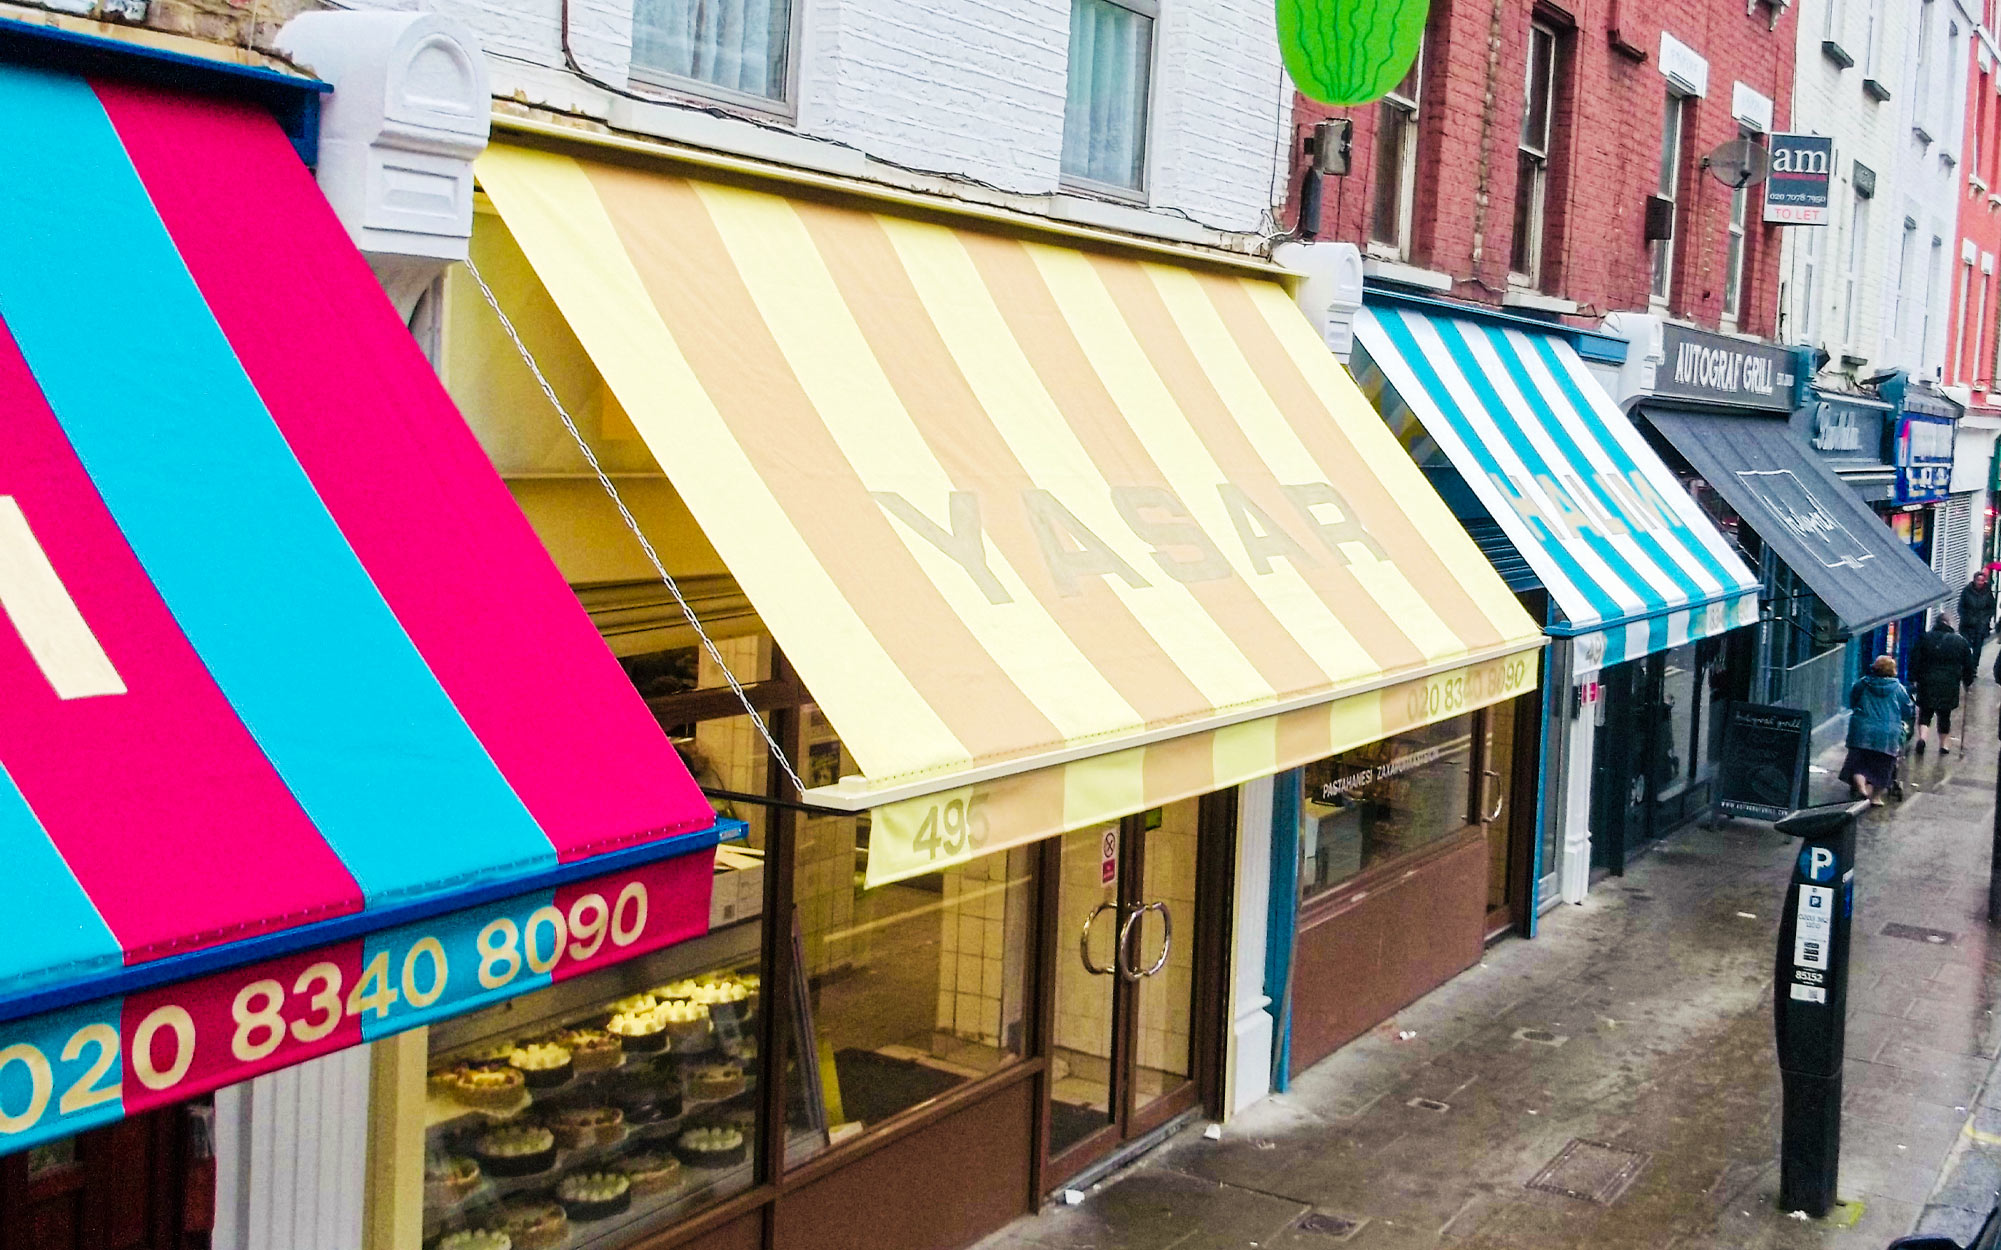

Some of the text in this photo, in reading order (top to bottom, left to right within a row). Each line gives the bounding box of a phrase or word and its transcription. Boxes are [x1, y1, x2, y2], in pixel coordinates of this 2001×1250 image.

[1773, 148, 1828, 173] am
[1769, 193, 1784, 201] 020
[1776, 208, 1820, 221] TO LET
[1674, 342, 1773, 395] AUTOGRAF GRILL
[1488, 470, 1682, 541] HALIM
[868, 481, 1389, 605] YASAR
[1408, 660, 1526, 721] 020 8340 8090
[912, 793, 990, 860] 495
[1810, 846, 1833, 880] P
[0, 881, 648, 1134] 020 8340 8090
